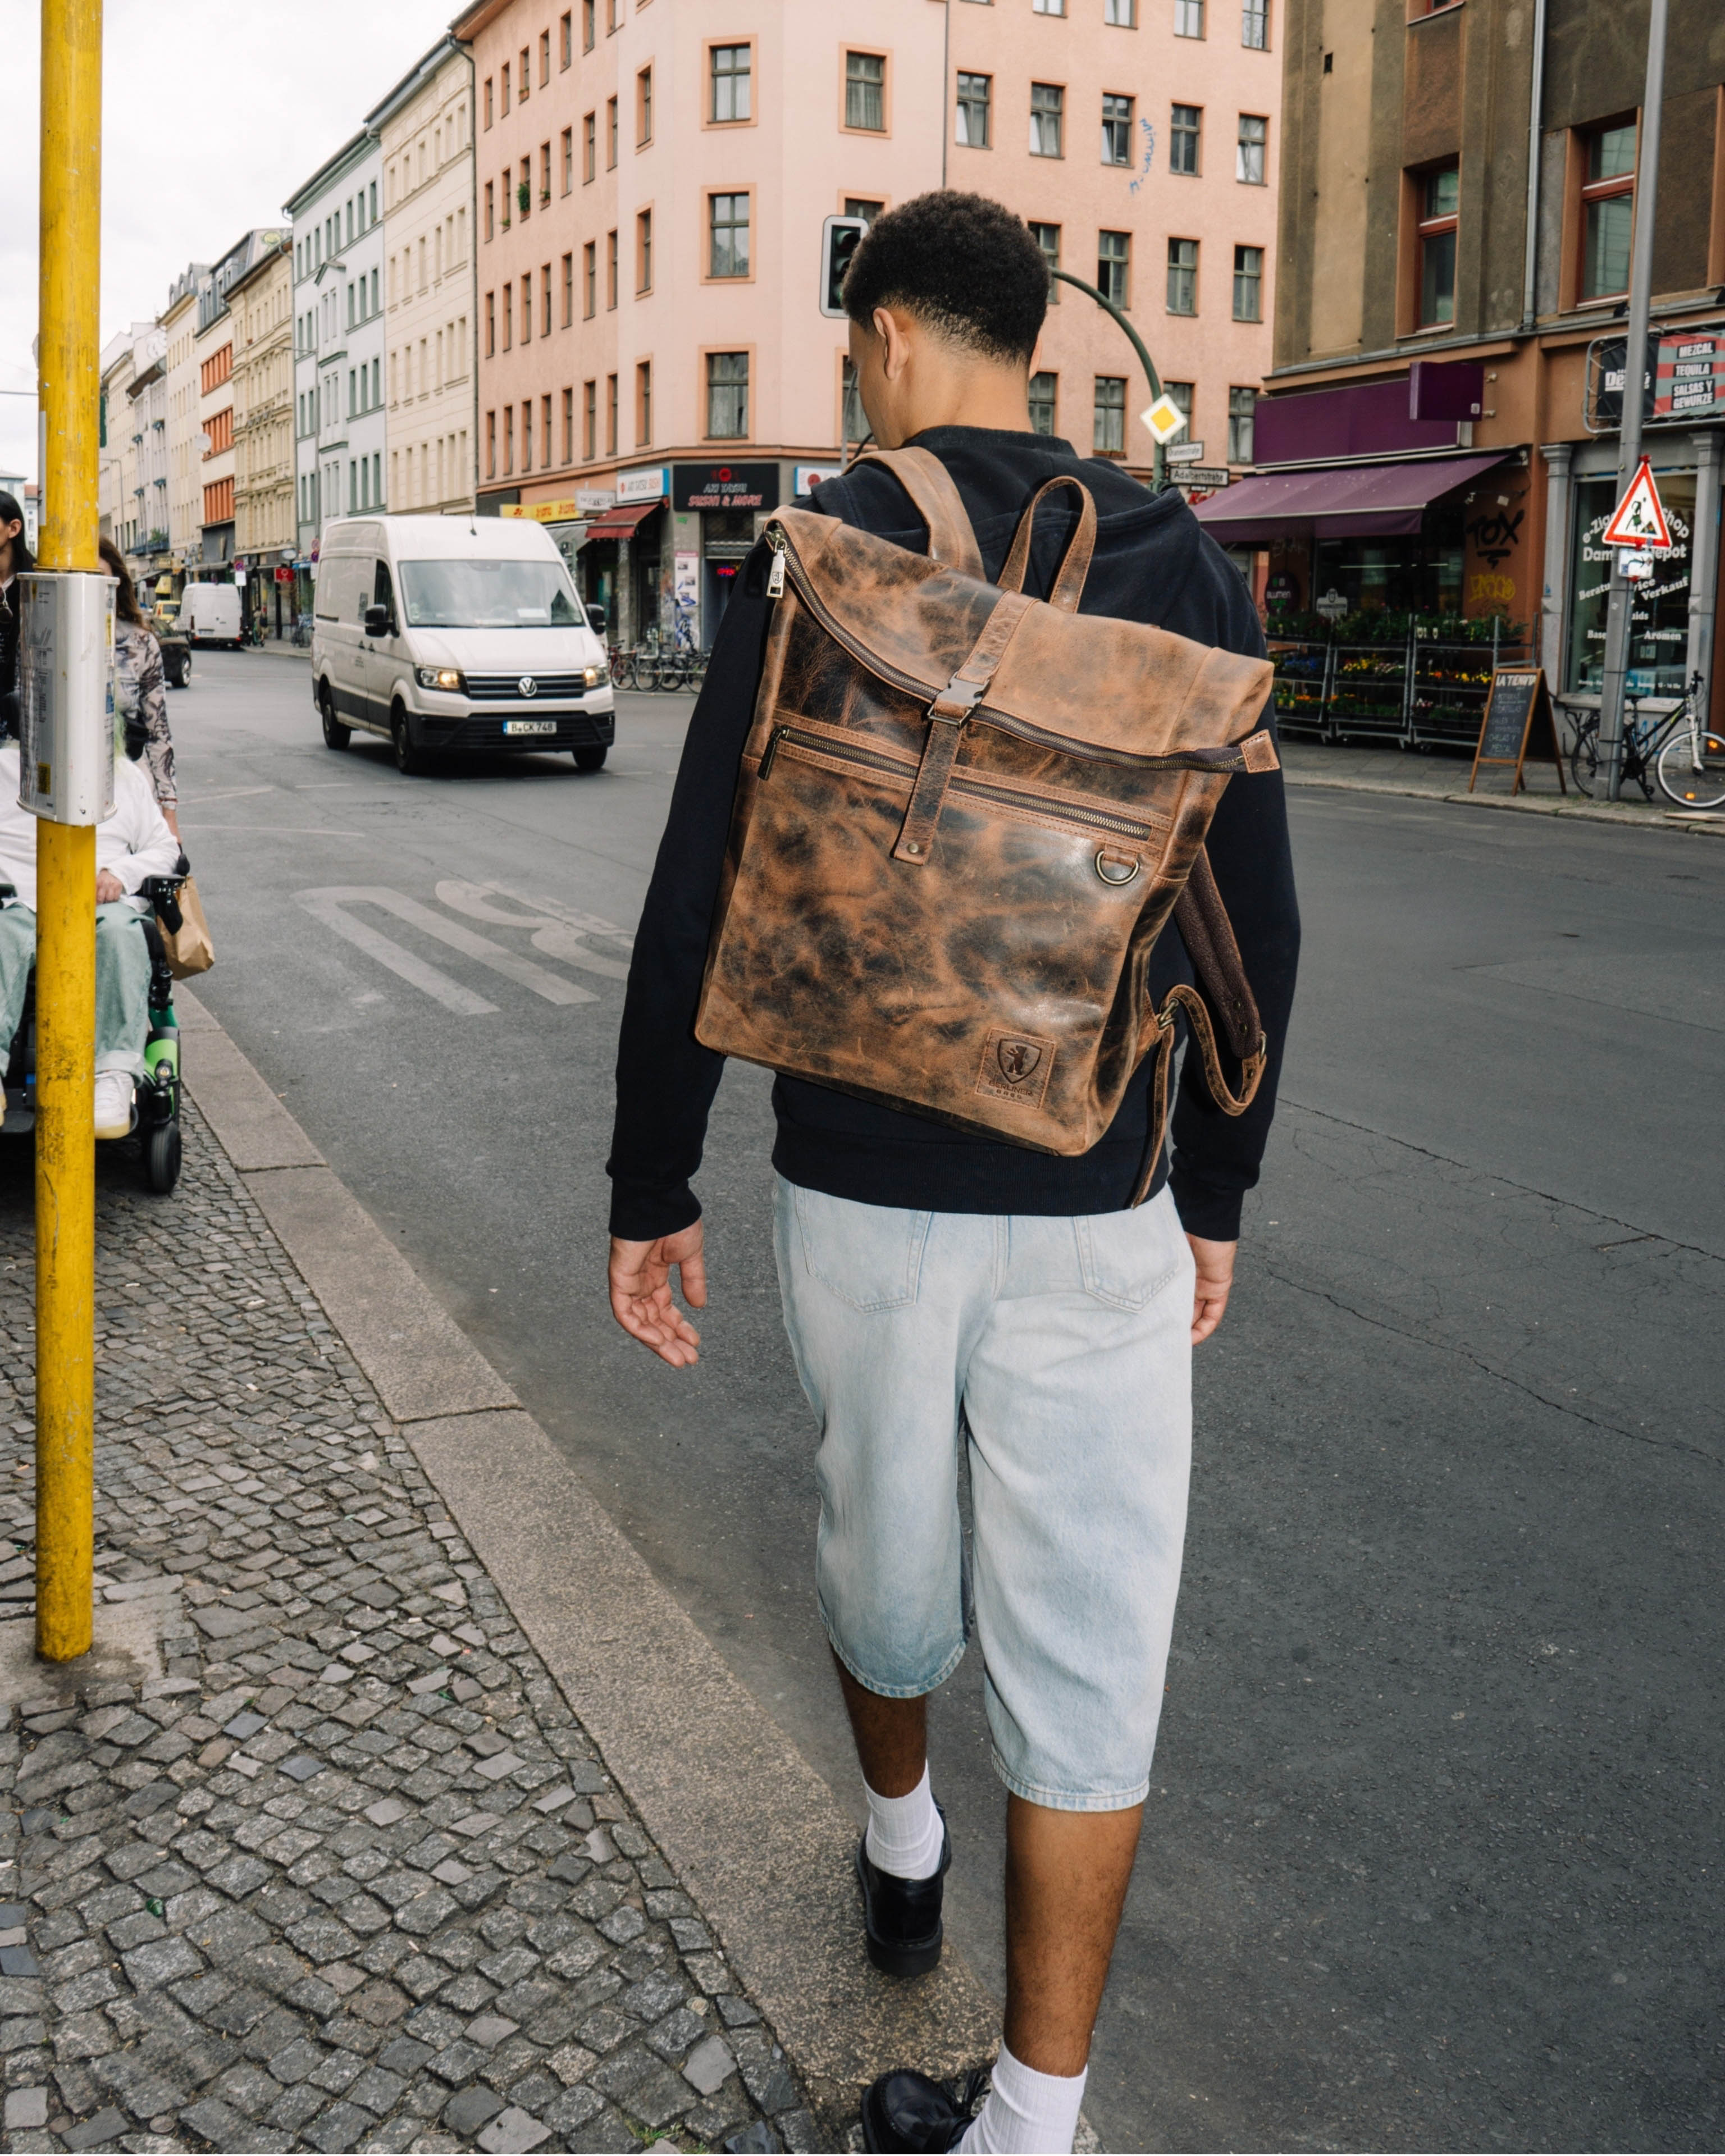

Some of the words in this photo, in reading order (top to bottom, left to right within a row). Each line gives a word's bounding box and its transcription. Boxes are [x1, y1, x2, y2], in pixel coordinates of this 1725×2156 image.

[1678, 342, 1713, 358] MEZCAL
[1676, 364, 1710, 376] TEQUILA
[1673, 381, 1704, 396] SALSAS
[1706, 380, 1713, 392] Y
[722, 495, 730, 506] &
[731, 495, 763, 506] MORE
[1641, 576, 1689, 601] Verkauf
[1644, 631, 1682, 640] Aromen
[989, 1080, 1034, 1097] BERLINER
